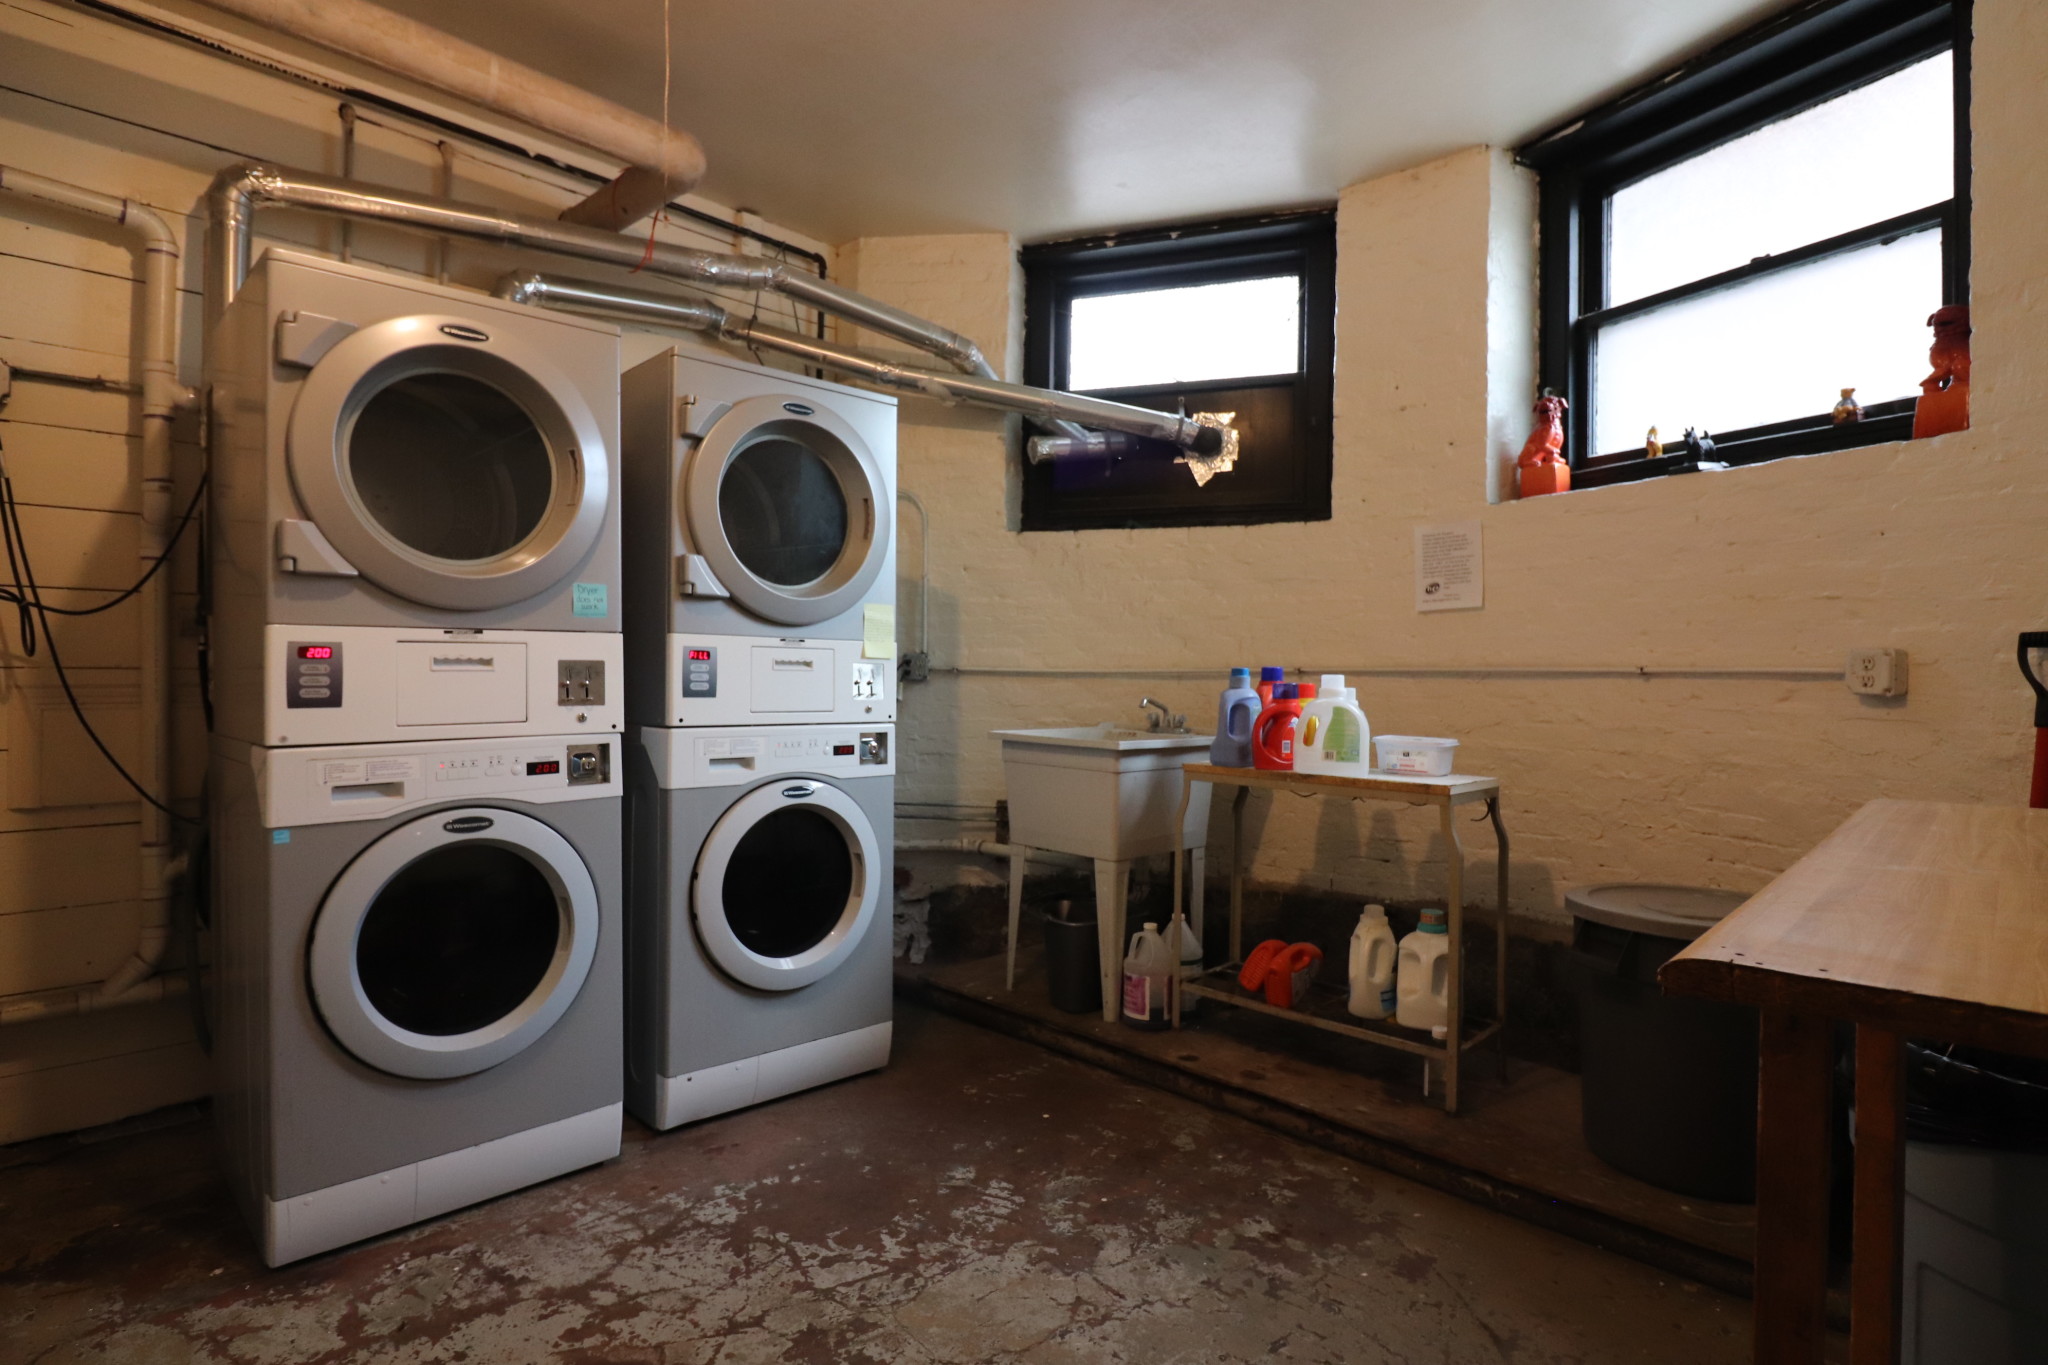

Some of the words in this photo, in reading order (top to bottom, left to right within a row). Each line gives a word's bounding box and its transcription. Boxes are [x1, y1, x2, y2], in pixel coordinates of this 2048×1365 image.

[577, 583, 598, 595] Dryer
[306, 647, 331, 659] 200
[689, 650, 709, 660] FILL
